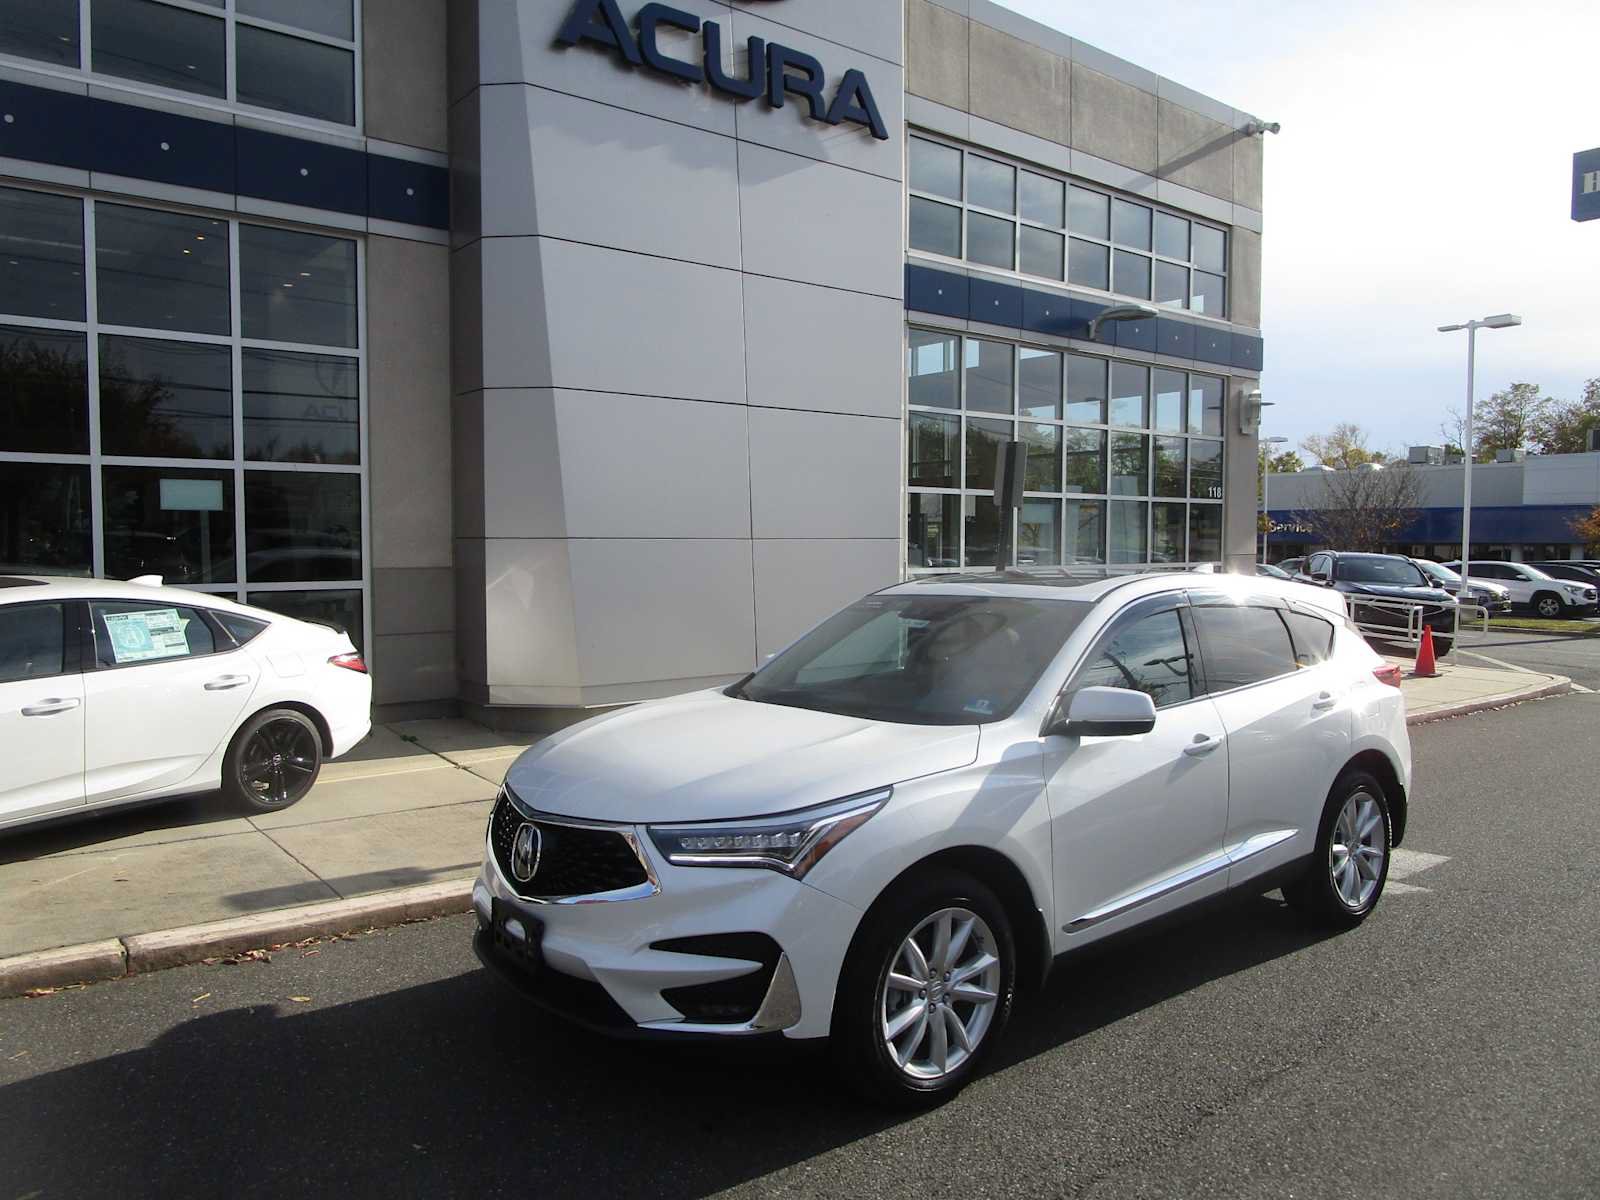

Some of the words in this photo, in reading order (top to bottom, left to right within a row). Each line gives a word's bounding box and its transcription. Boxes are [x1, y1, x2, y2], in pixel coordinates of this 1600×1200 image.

[552, 0, 889, 140] ACURA
[1208, 486, 1222, 498] 118
[1268, 520, 1313, 533] Service
